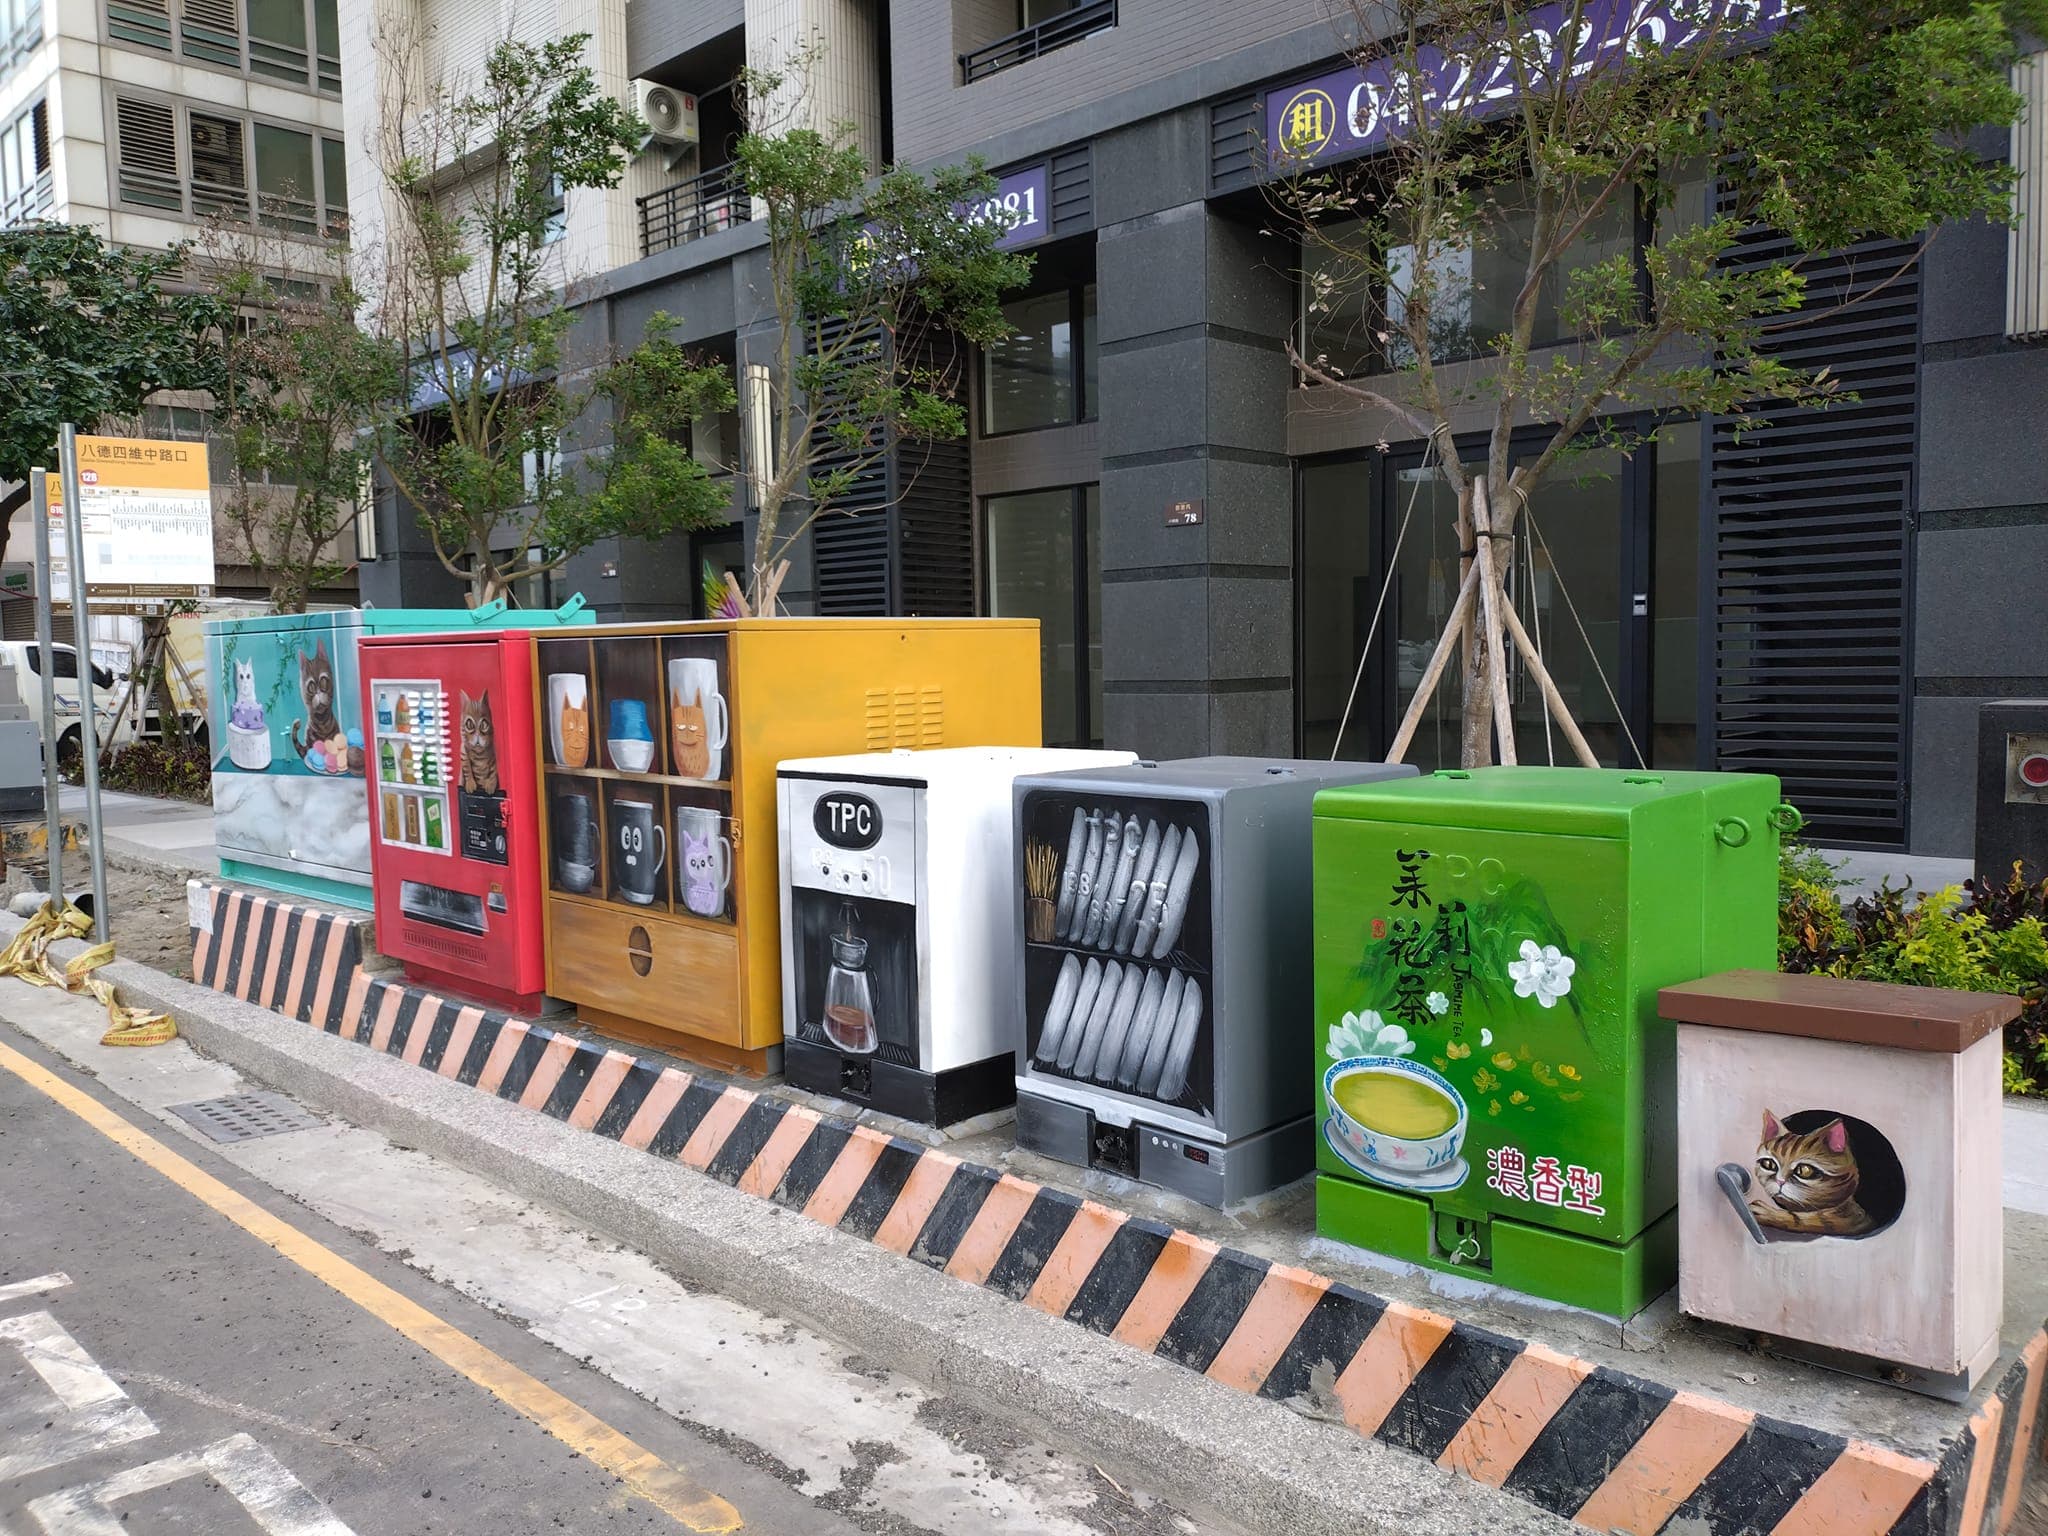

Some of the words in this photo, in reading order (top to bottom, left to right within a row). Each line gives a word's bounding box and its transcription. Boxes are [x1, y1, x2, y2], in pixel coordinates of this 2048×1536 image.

[1286, 94, 1328, 150] 租
[80, 444, 188, 462] 八德四維中路口
[81, 472, 98, 482] 128
[1184, 513, 1197, 523] 78
[826, 801, 872, 836] TPC
[1453, 1020, 1464, 1038] TEA
[1487, 1146, 1606, 1216] 濃香型
